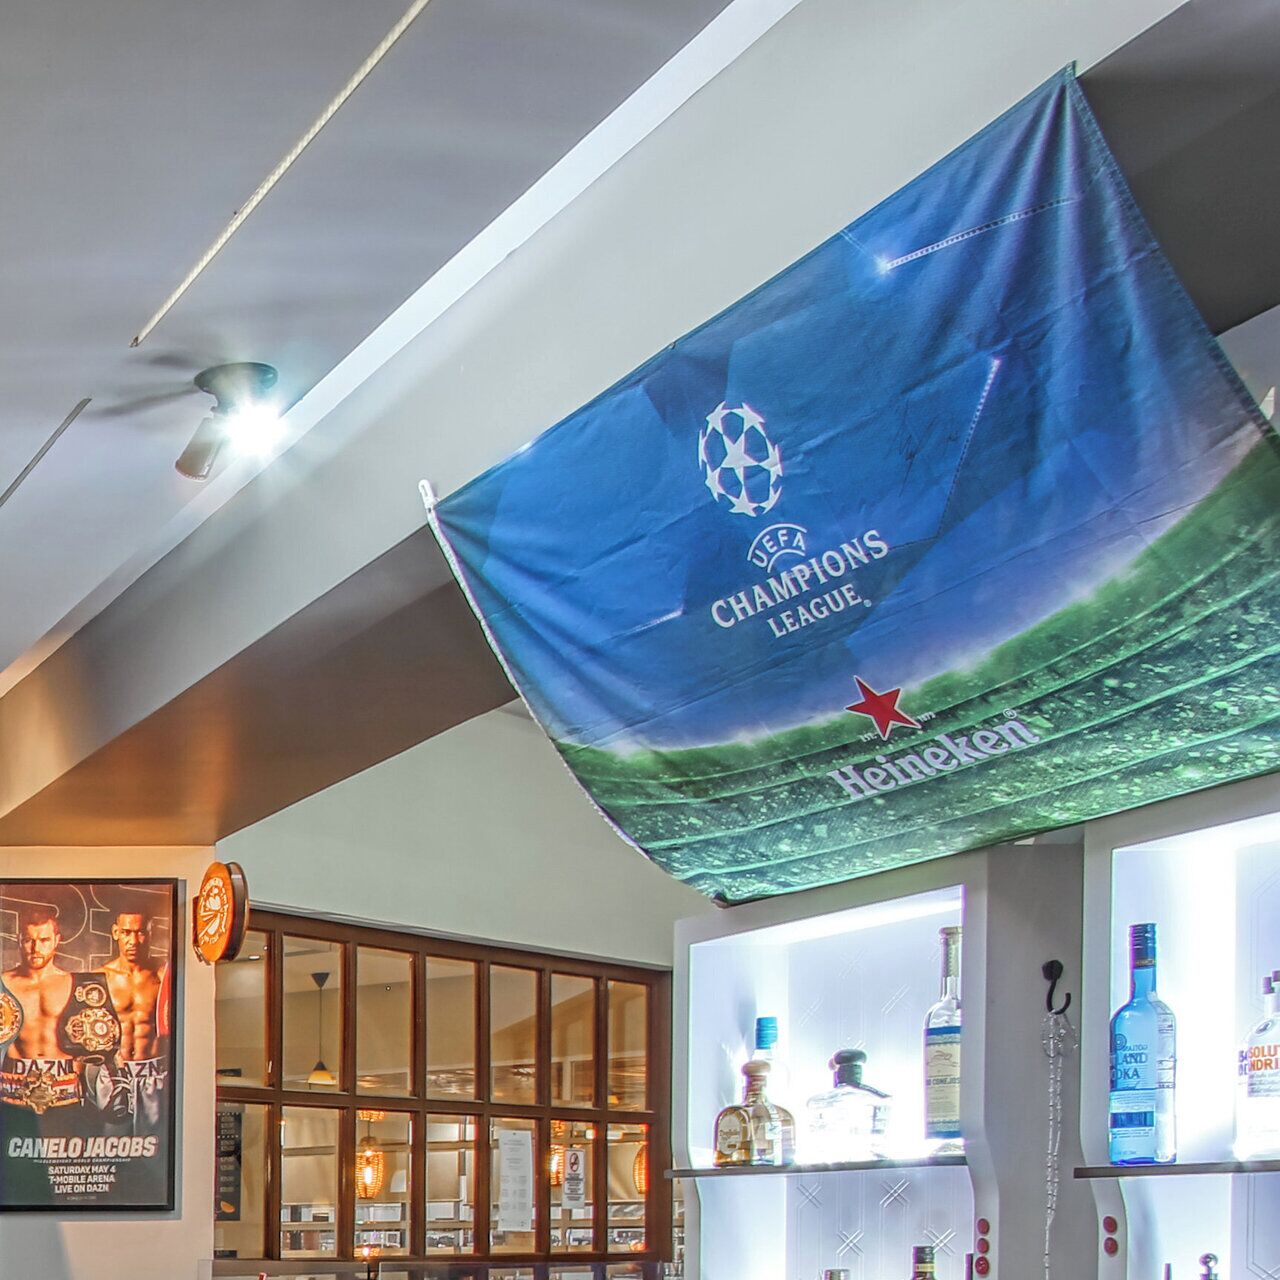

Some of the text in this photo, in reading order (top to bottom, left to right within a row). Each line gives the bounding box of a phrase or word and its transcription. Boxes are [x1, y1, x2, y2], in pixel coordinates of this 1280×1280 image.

[751, 529, 806, 568] UEFA
[710, 529, 889, 629] CHAMPIONS
[767, 583, 863, 638] LEAGUE
[14, 1059, 68, 1077] DAZN
[8, 1135, 157, 1158] CANELO JACOBS
[48, 1174, 116, 1184] T-MOBILE ARENA
[91, 1165, 109, 1174] MAY
[109, 1165, 117, 1174] 4
[54, 1183, 110, 1193] LIVE ON DAZN
